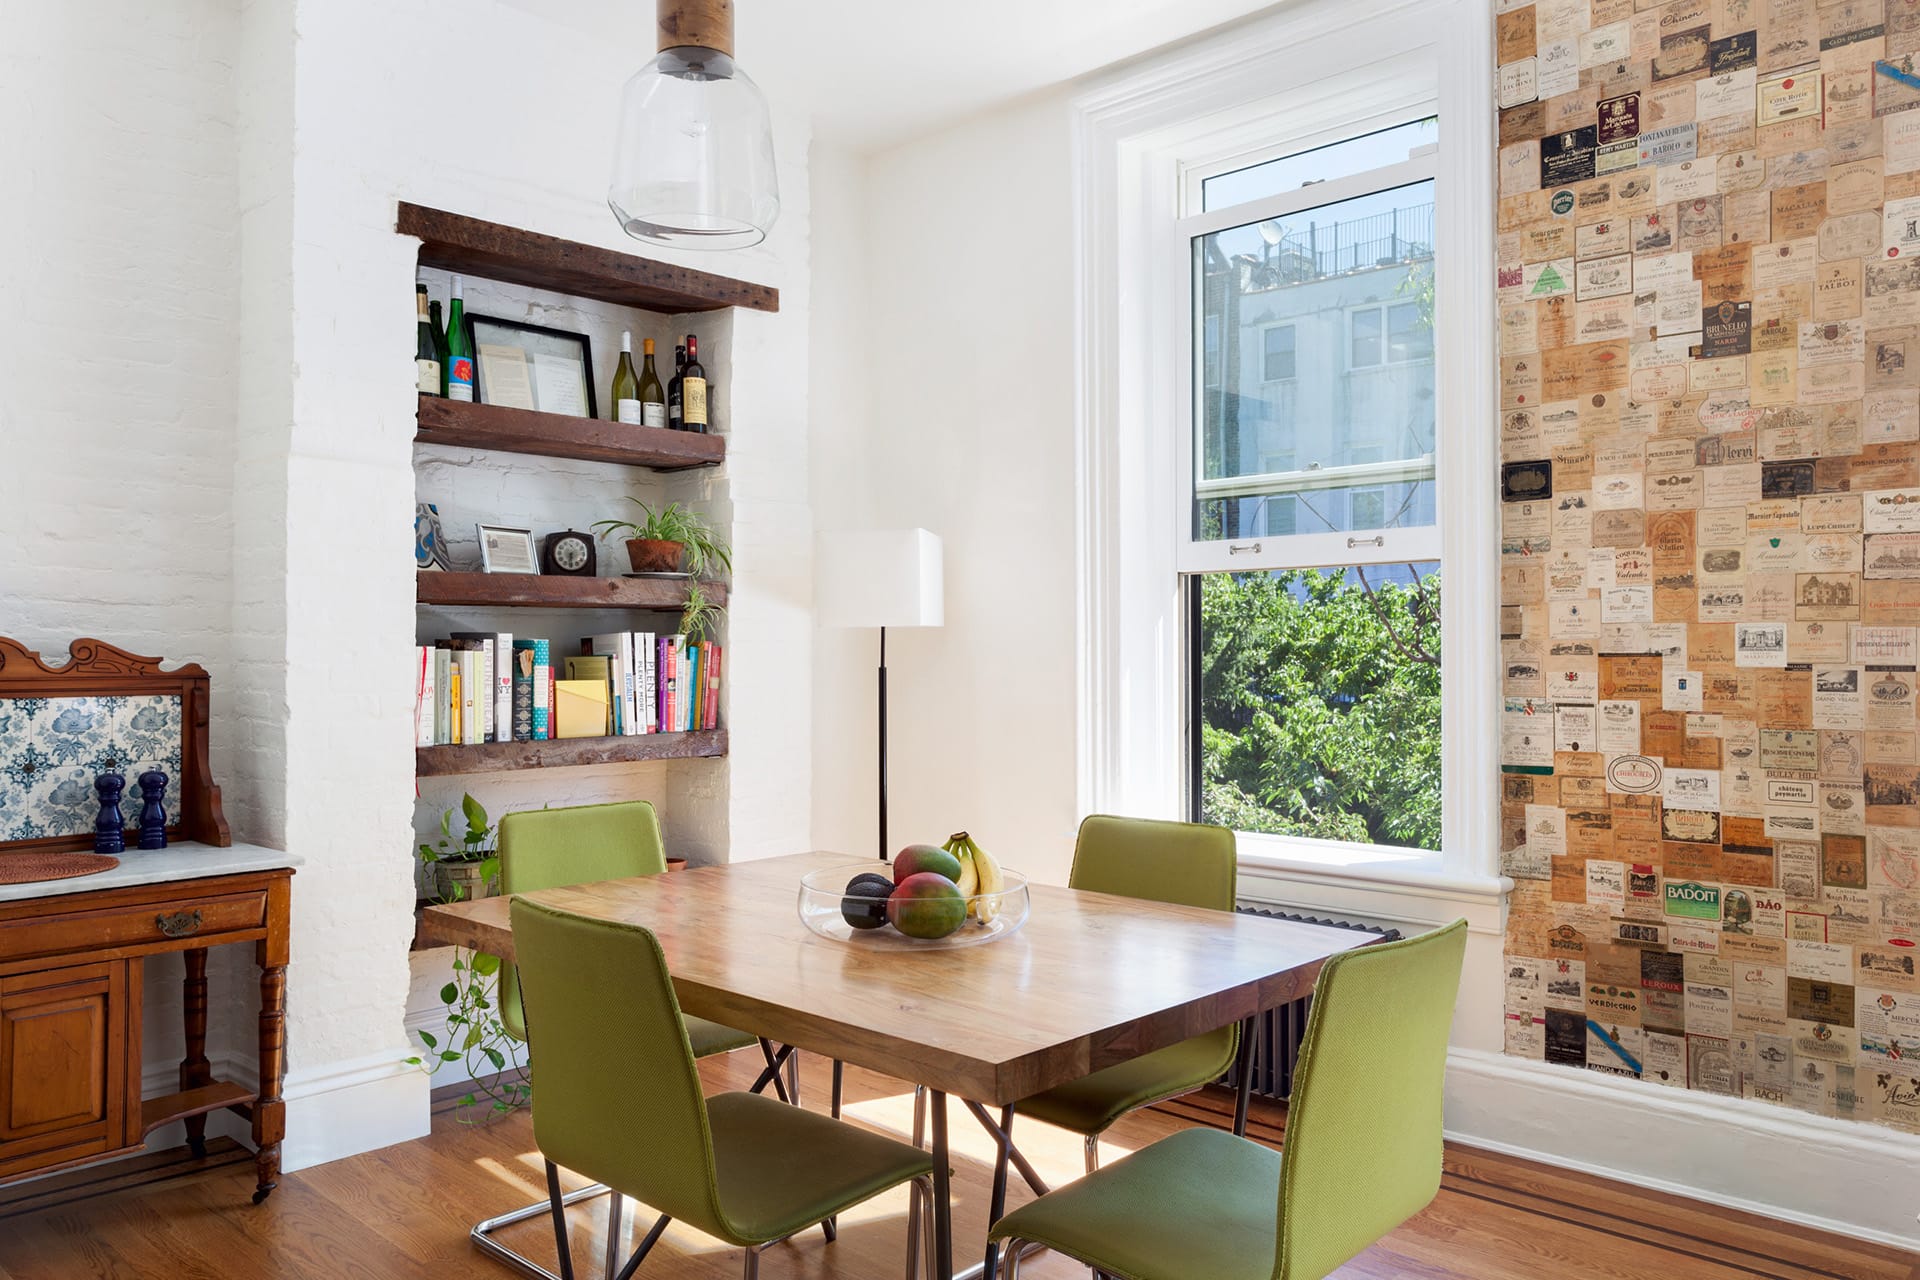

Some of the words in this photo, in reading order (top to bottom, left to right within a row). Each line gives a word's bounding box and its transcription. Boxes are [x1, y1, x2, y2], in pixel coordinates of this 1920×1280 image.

[1660, 11, 1703, 27] Chinon
[1652, 143, 1681, 155] BAROLO
[1776, 200, 1825, 213] MACALLAN
[1818, 279, 1857, 292] TALBOT
[1706, 321, 1747, 334] BRUNELLO
[1761, 327, 1788, 337] BAROLO
[1714, 337, 1738, 346] NARDI
[646, 661, 655, 709] PLENTY
[1766, 770, 1795, 779] BULLY
[1799, 771, 1819, 780] HILL
[1667, 887, 1717, 903] BADOIT
[1642, 980, 1680, 991] LEROUX
[1588, 998, 1637, 1012] VERDICCHIO
[1755, 1089, 1783, 1101] BACH
